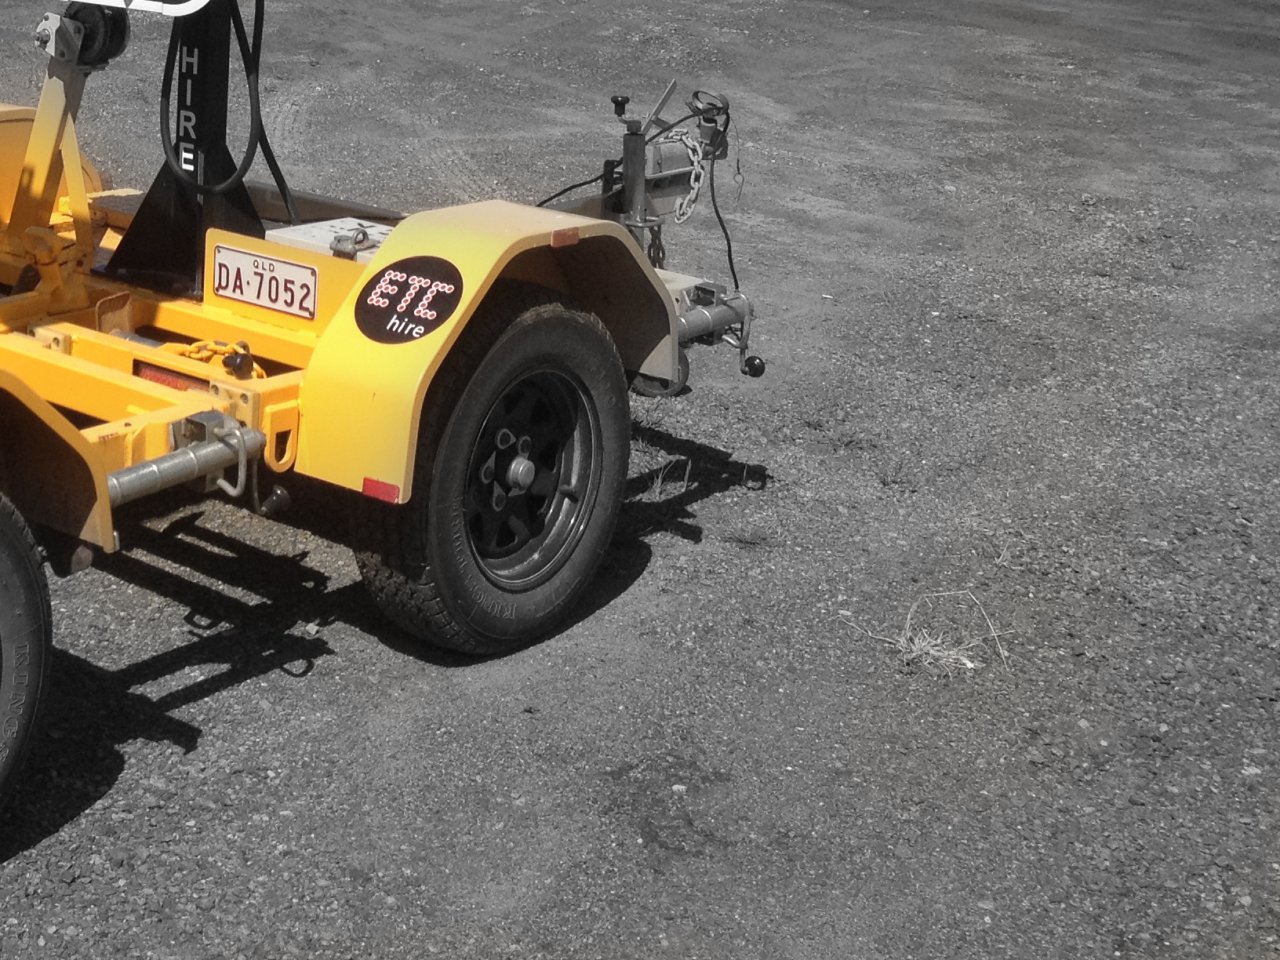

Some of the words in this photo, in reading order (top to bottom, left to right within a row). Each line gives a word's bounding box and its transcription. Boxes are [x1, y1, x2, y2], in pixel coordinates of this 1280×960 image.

[178, 45, 199, 172] HIRE
[253, 259, 276, 273] QLD
[367, 270, 455, 320] ETC
[386, 315, 426, 338] hire
